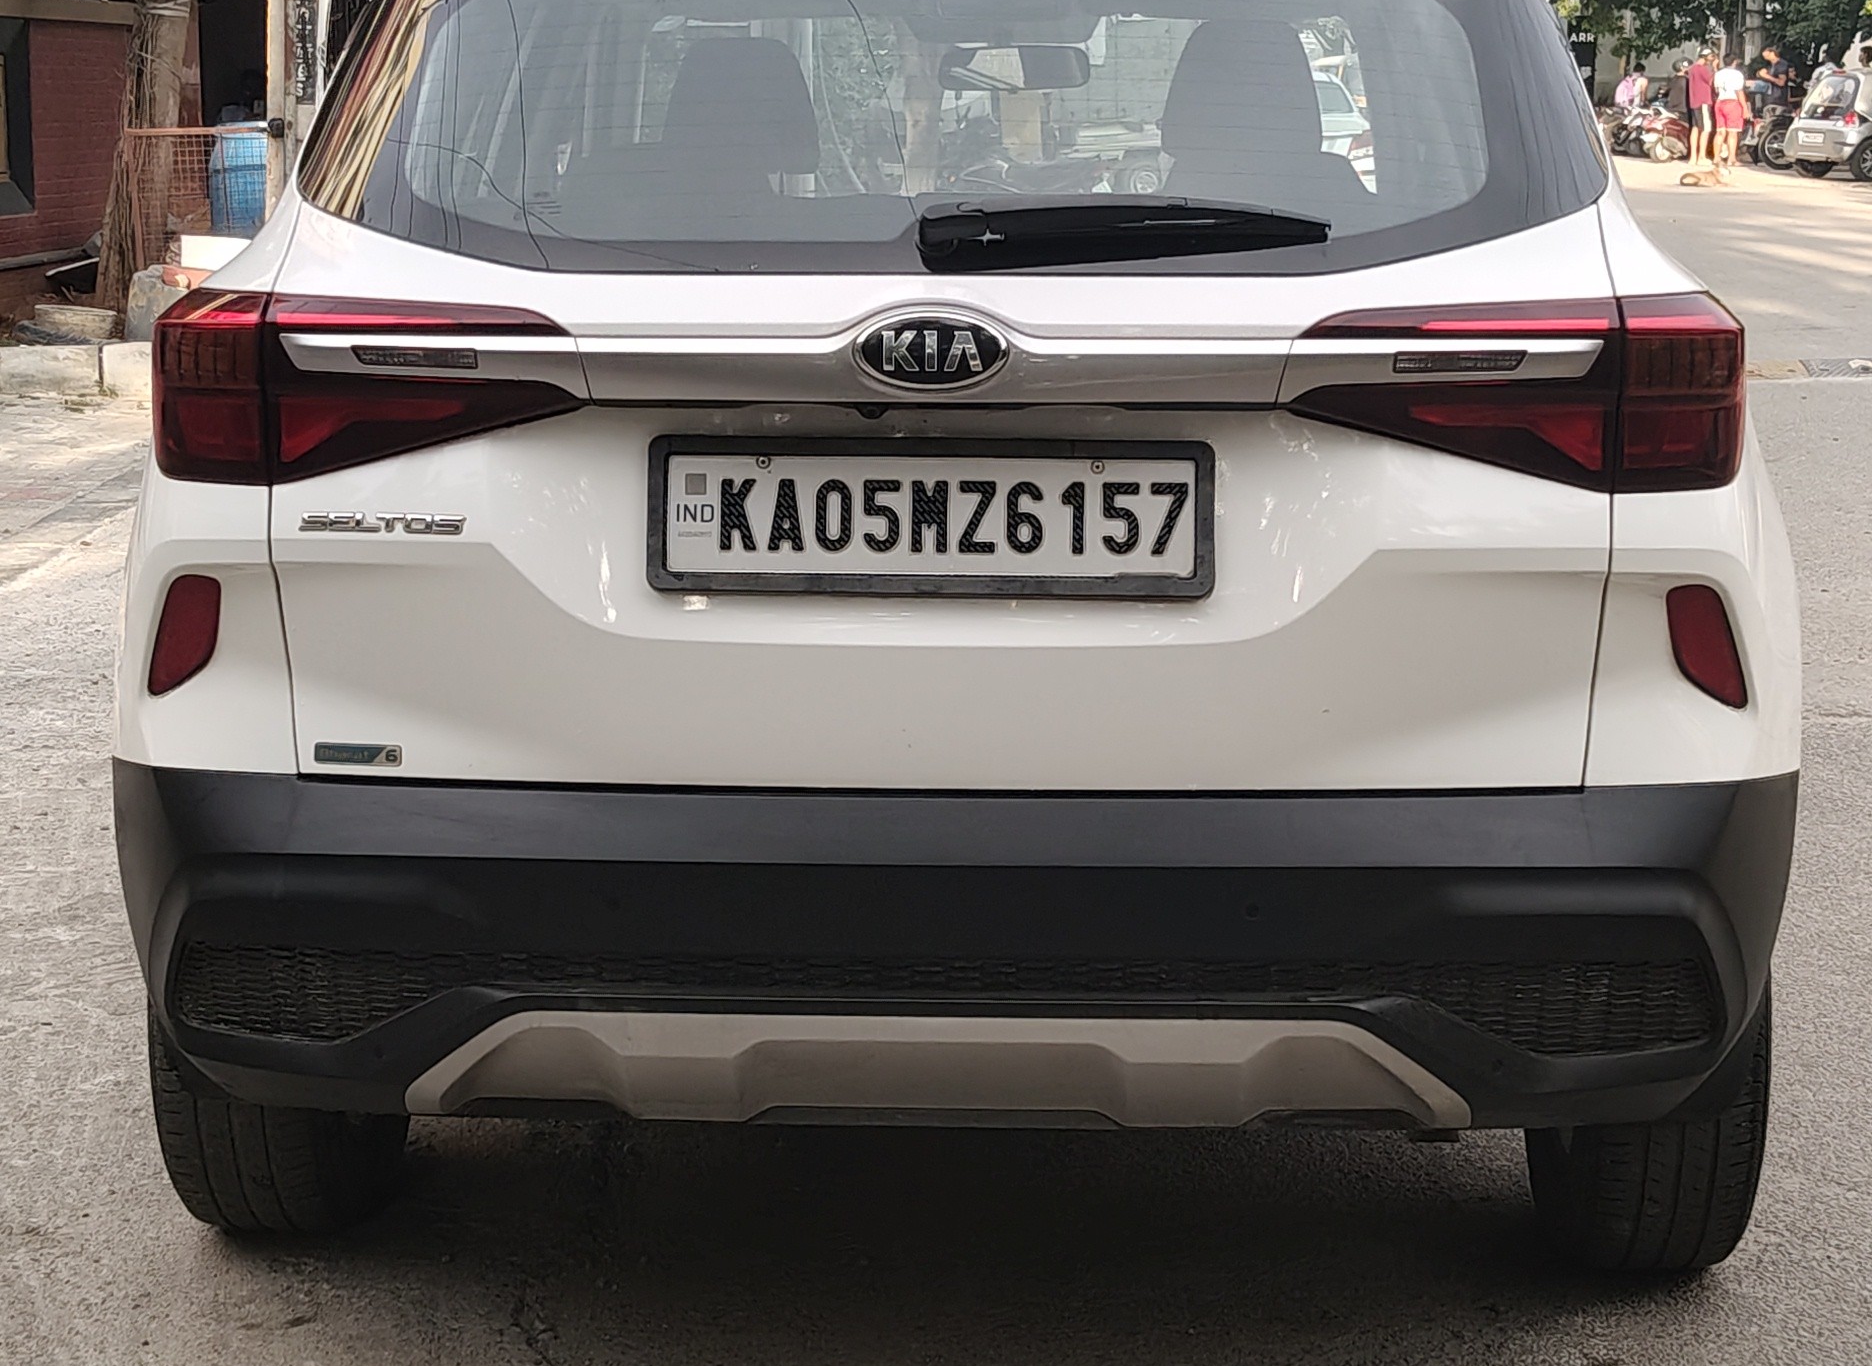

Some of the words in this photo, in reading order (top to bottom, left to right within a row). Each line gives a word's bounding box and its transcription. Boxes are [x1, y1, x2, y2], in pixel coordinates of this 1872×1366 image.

[881, 330, 983, 372] KIA
[299, 511, 467, 535] SELTOS
[676, 503, 714, 523] IND
[719, 478, 1189, 556] KA05MZ6157
[385, 749, 399, 763] 6
